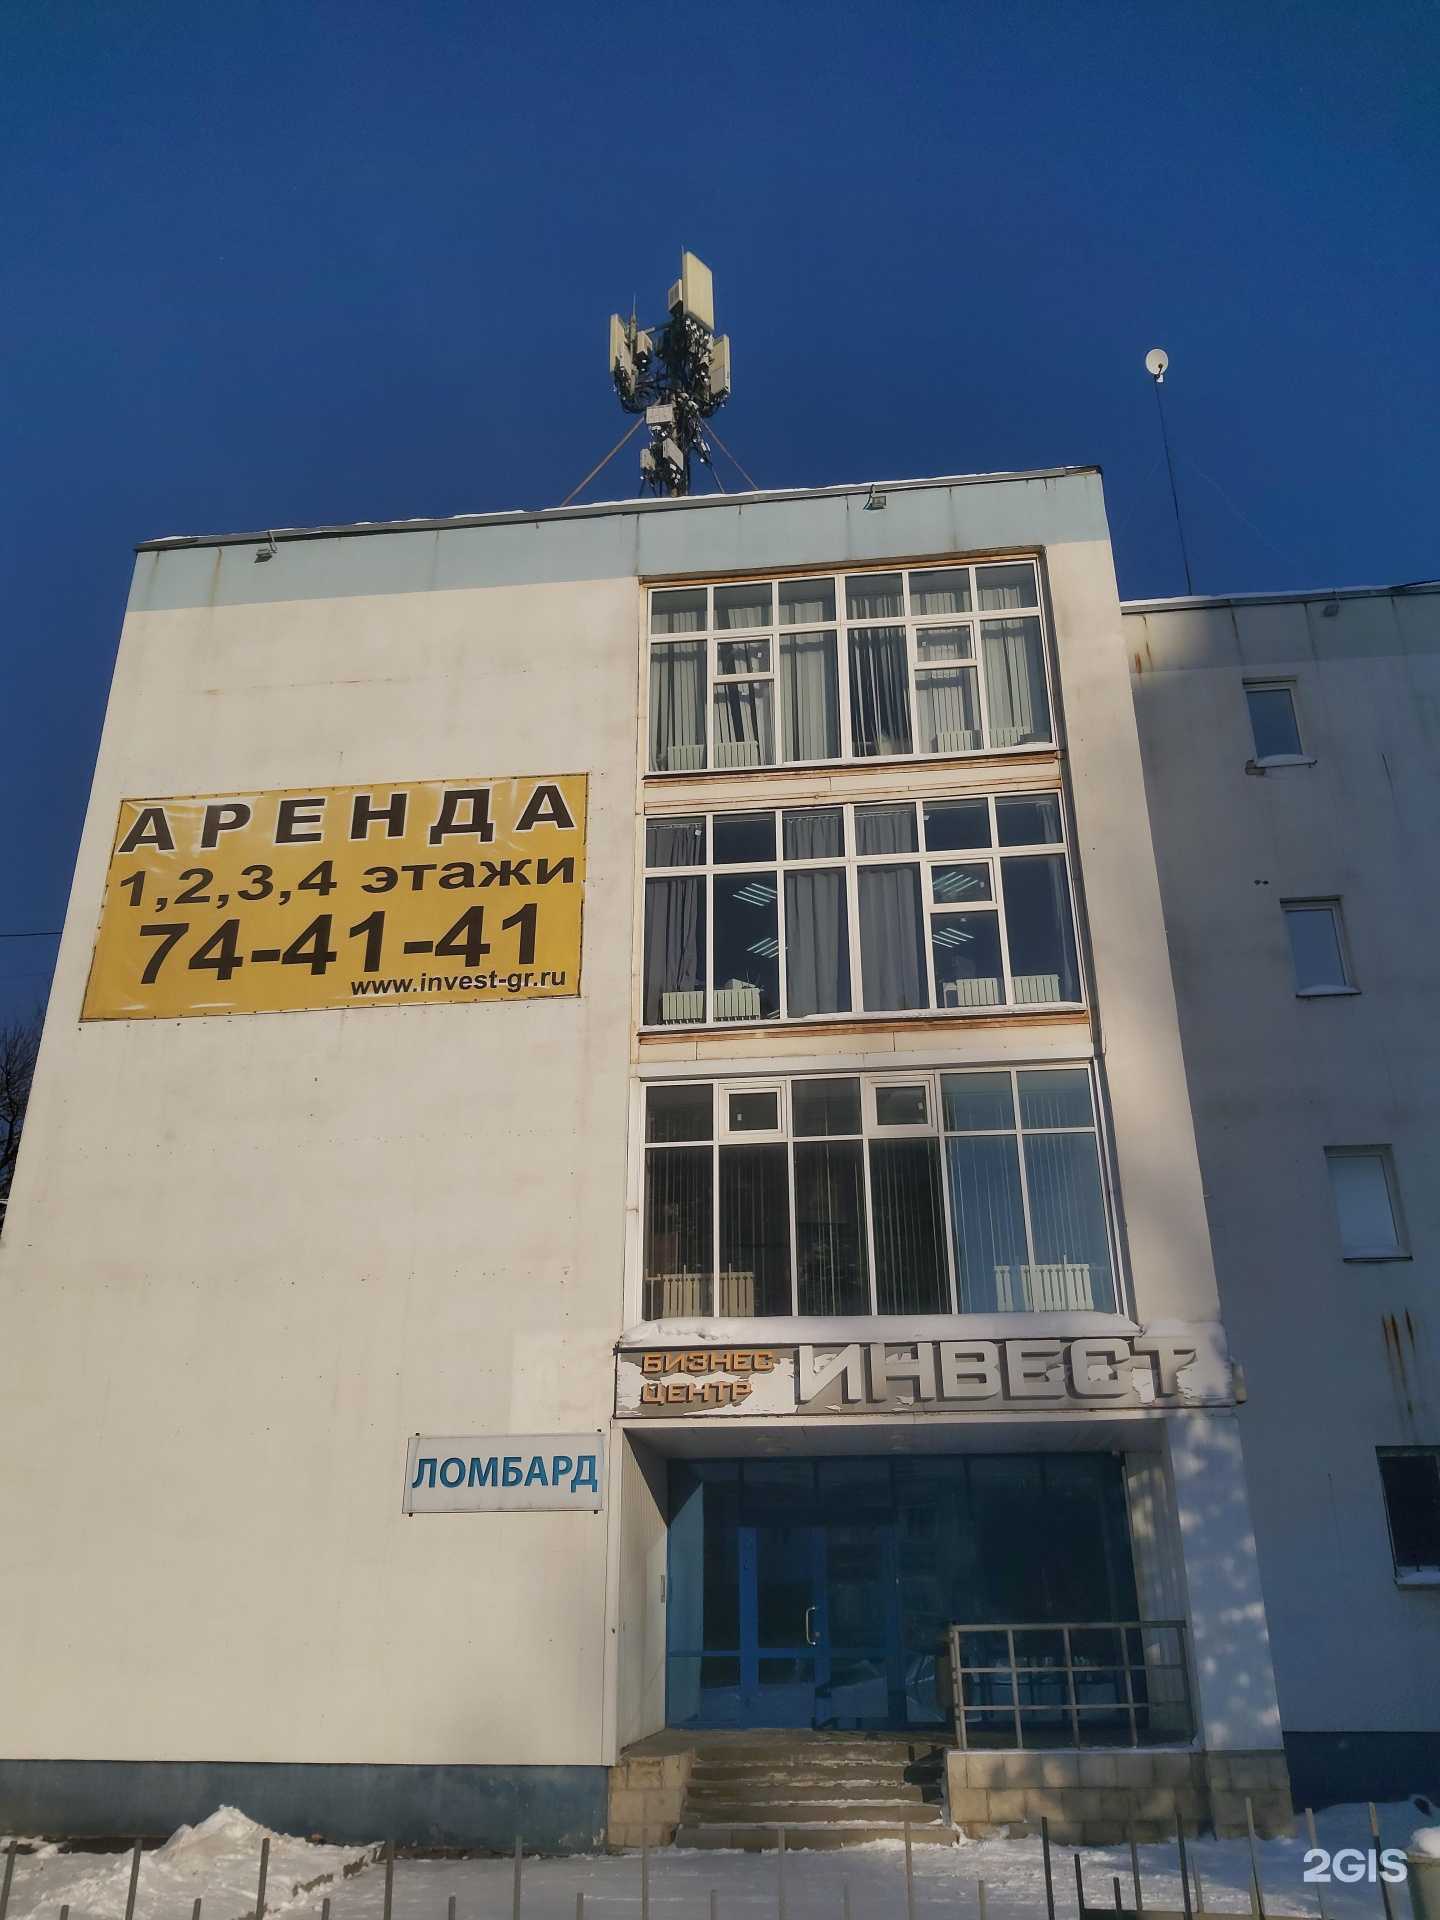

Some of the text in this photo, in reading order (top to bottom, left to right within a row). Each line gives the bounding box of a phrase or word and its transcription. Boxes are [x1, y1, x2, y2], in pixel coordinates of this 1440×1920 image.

[119, 784, 575, 853] АРЕНДА
[119, 857, 575, 912] 1,2,3,4 этажи
[139, 903, 539, 985] 74-41-41
[351, 970, 566, 996] www.invest-gr.ru
[642, 1351, 774, 1373] БИЗНЕС
[798, 1338, 1198, 1400] ИНВЕСТ
[643, 1380, 752, 1402] ЦЕНТР
[412, 1455, 598, 1493] ЛОМБАРД
